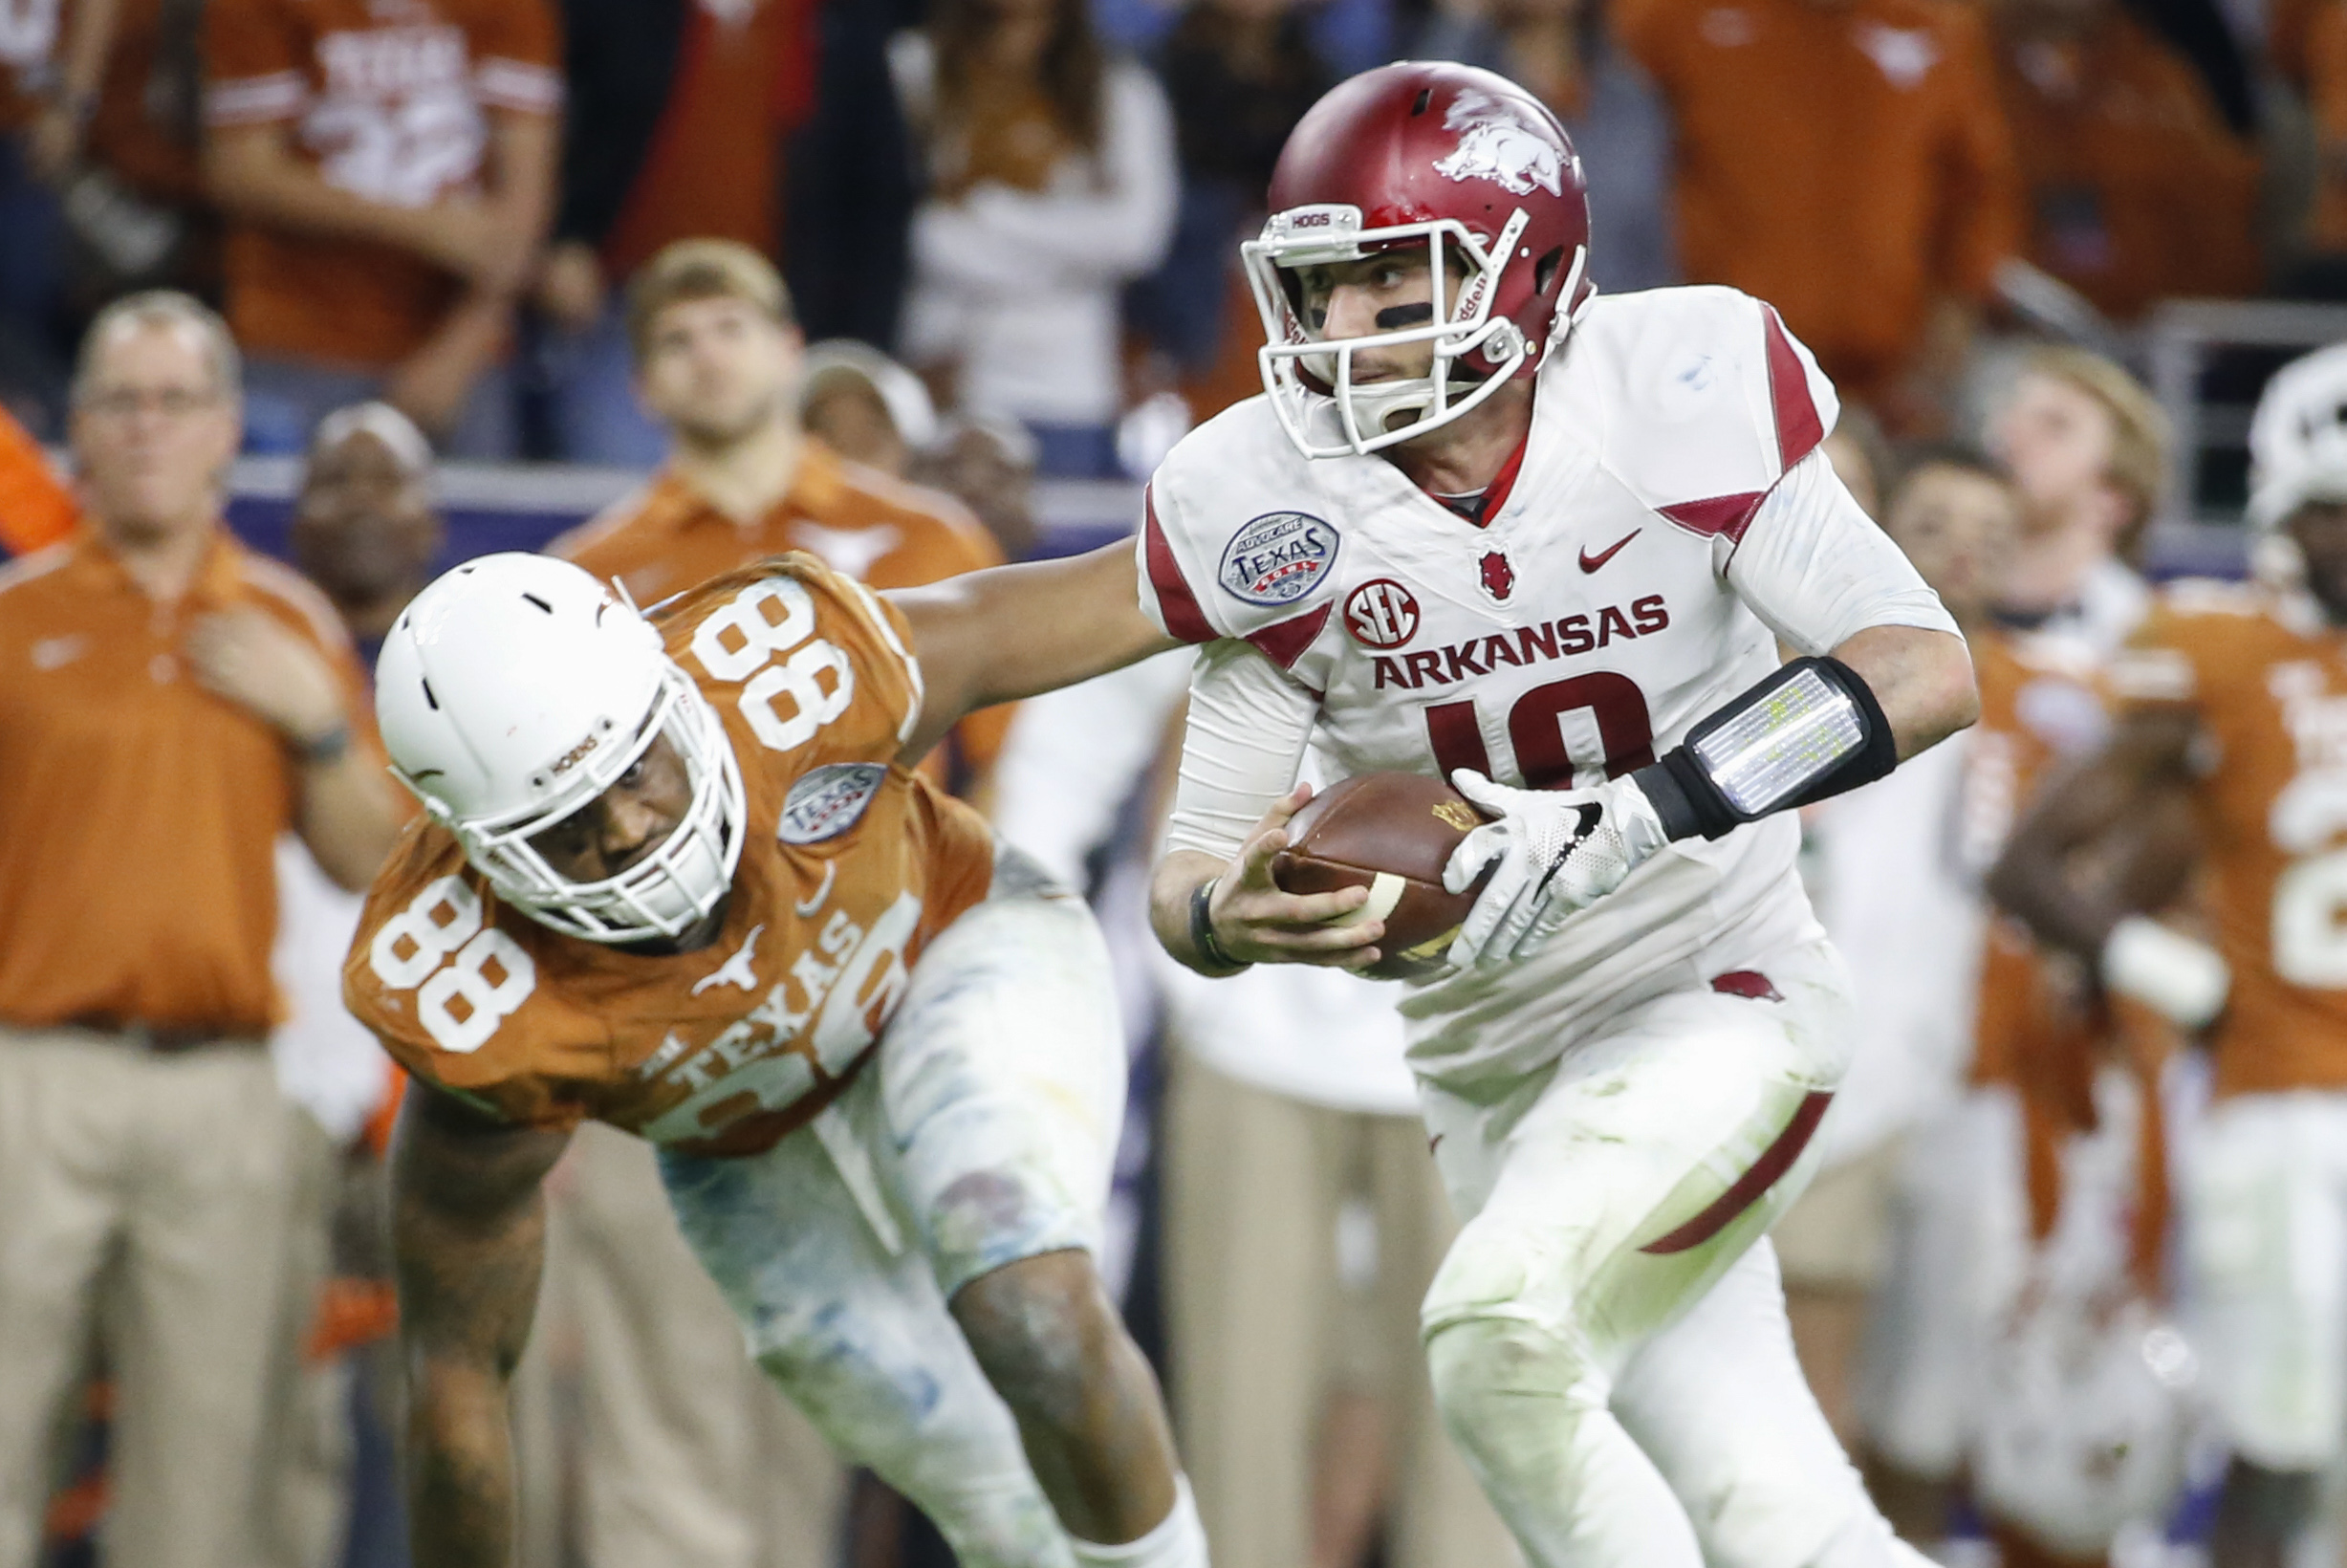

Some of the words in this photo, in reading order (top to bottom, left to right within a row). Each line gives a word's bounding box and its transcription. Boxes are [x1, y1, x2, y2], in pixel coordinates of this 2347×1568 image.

[1293, 212, 1331, 229] HOGS
[1455, 276, 1488, 325] ddell
[1230, 527, 1326, 585] TEXAS
[1236, 517, 1303, 555] ADVOCARE
[1347, 582, 1417, 645] SEC
[1371, 594, 1670, 689] ARKANSAS
[689, 576, 854, 751] 88
[369, 873, 536, 1054] 88
[665, 907, 863, 1089] TEXAS
